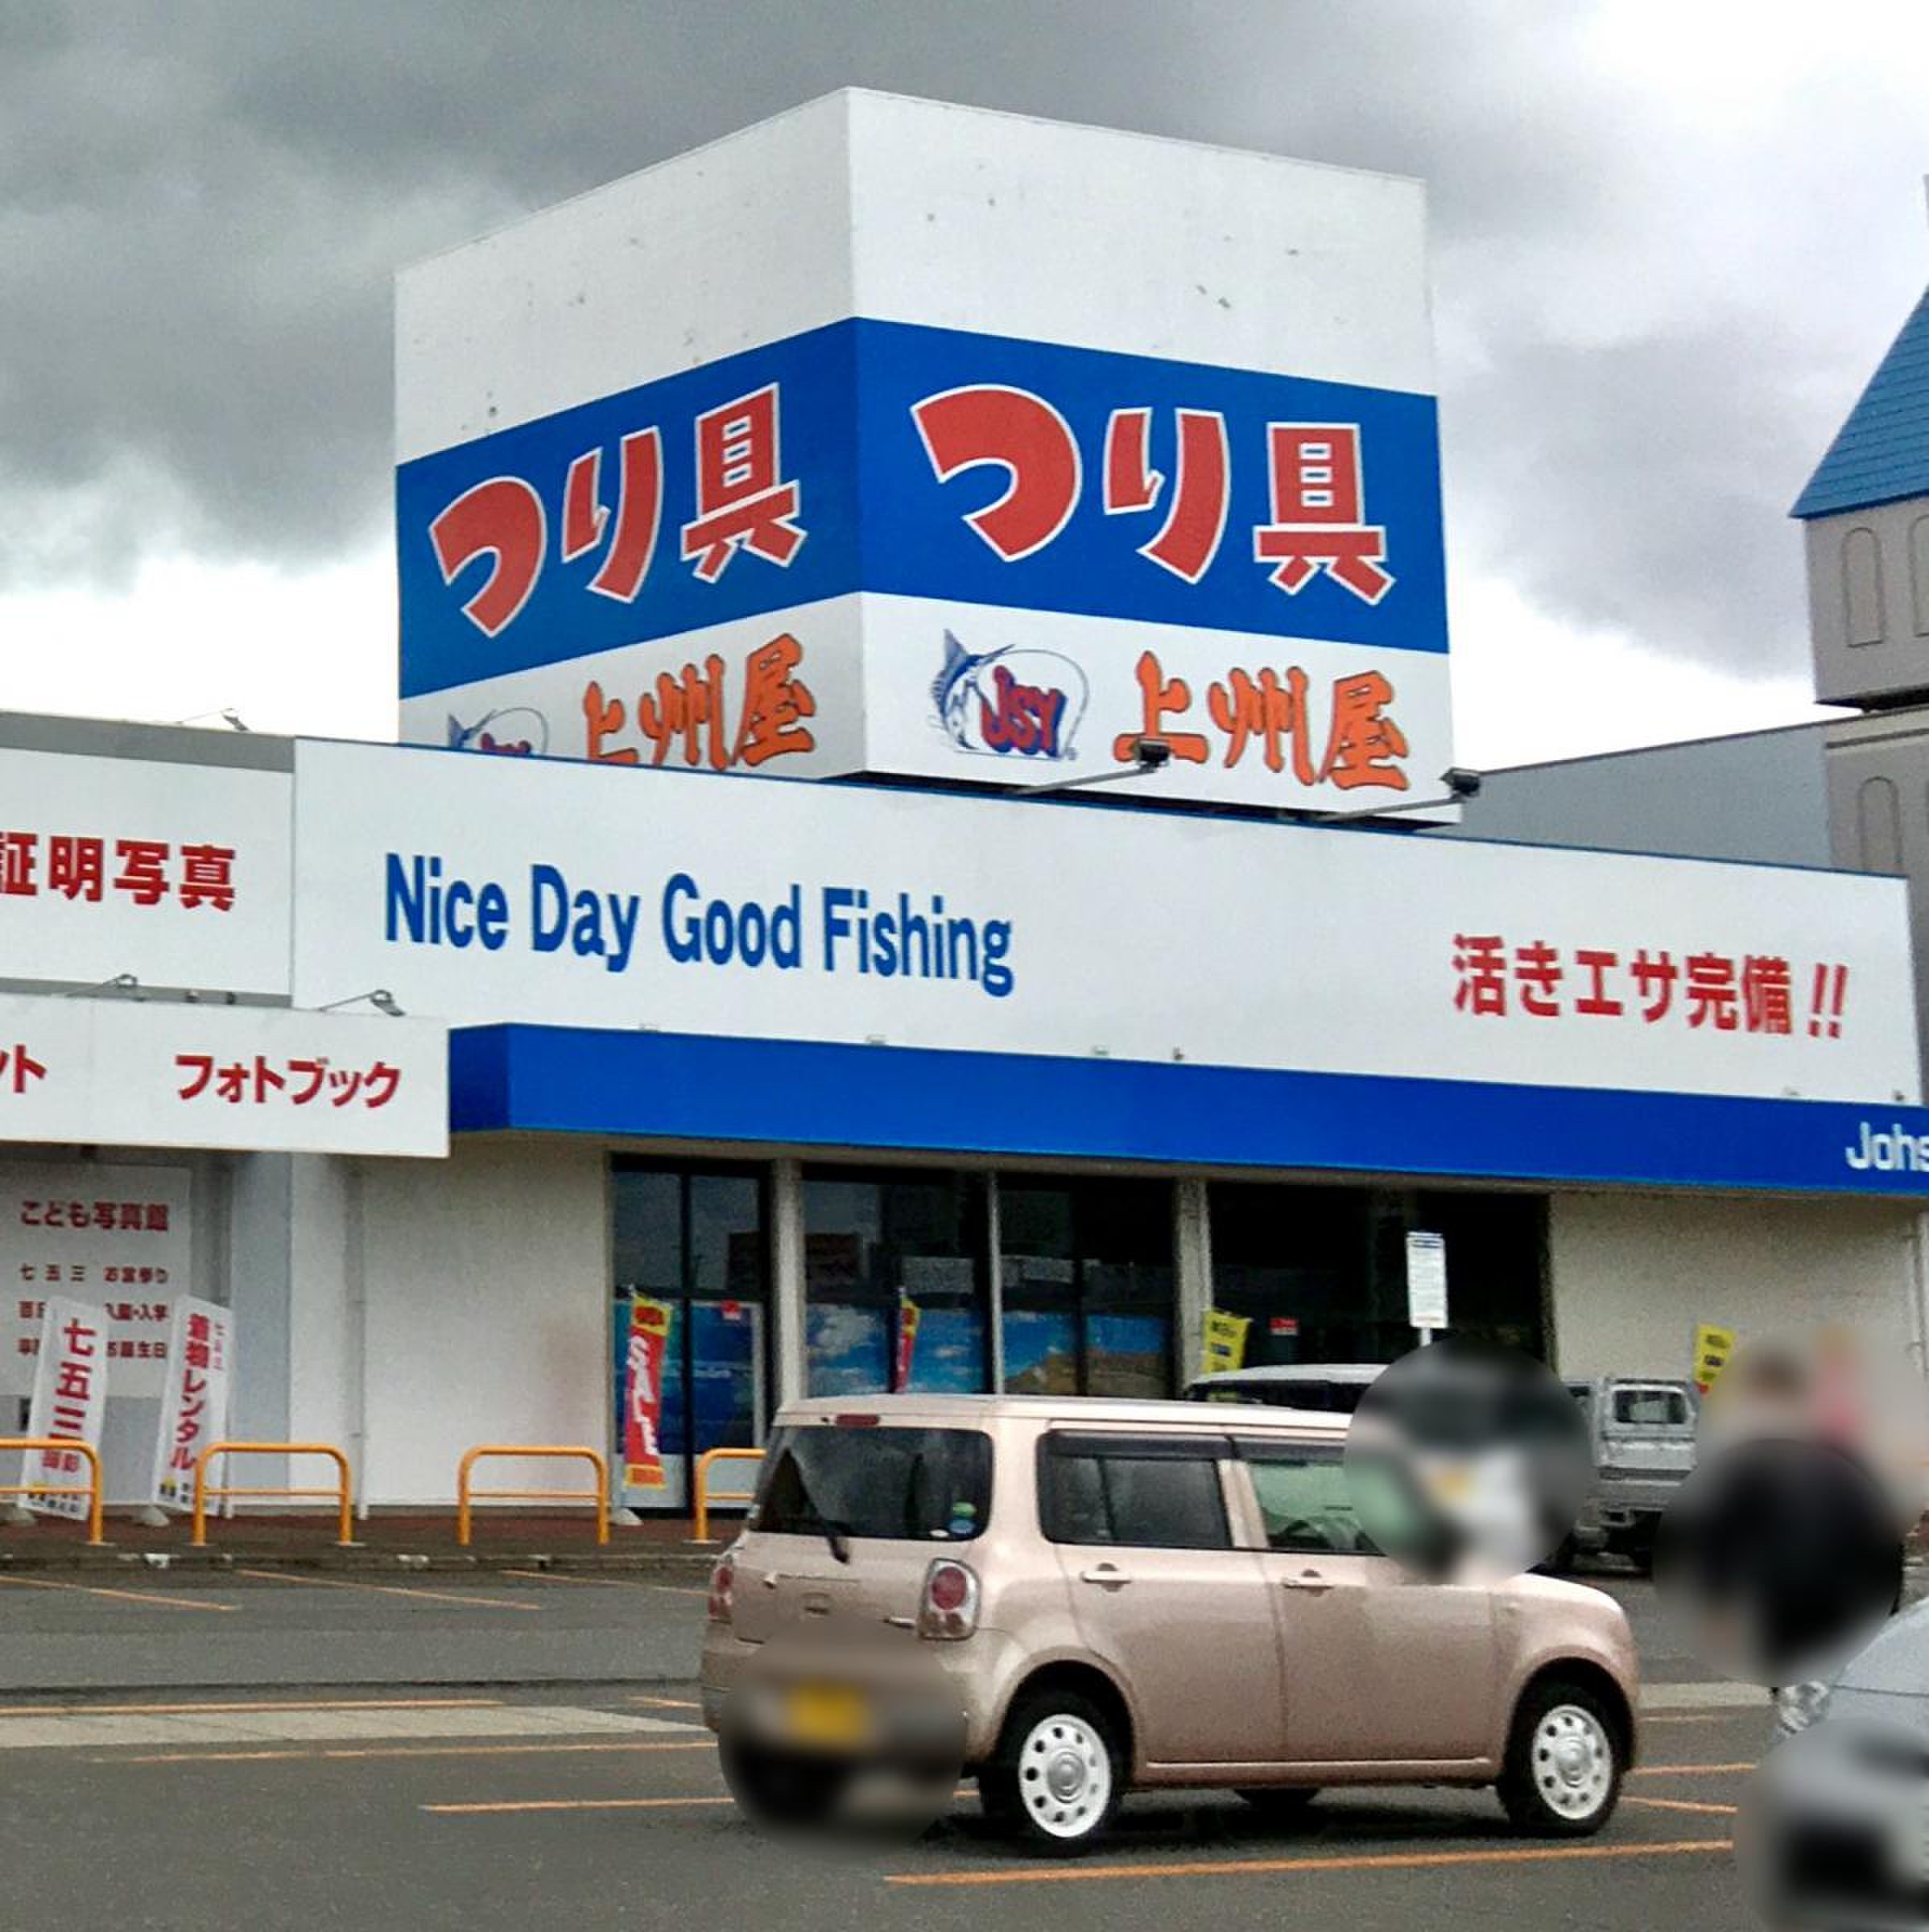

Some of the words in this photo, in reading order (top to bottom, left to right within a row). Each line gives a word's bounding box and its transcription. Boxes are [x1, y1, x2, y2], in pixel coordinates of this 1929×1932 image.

[428, 382, 808, 638] つり具
[910, 383, 1396, 606] つり具
[584, 634, 816, 770] 上州屋
[981, 664, 1068, 758] JSY
[1113, 650, 1409, 791] 上州屋
[0, 831, 236, 912] 証明写真
[386, 852, 509, 951] Nice
[531, 863, 641, 972] Day
[662, 872, 801, 969] Good
[821, 886, 1014, 998] Fishing
[175, 1055, 401, 1108] フォトブック
[20, 1200, 169, 1232] こども写真館
